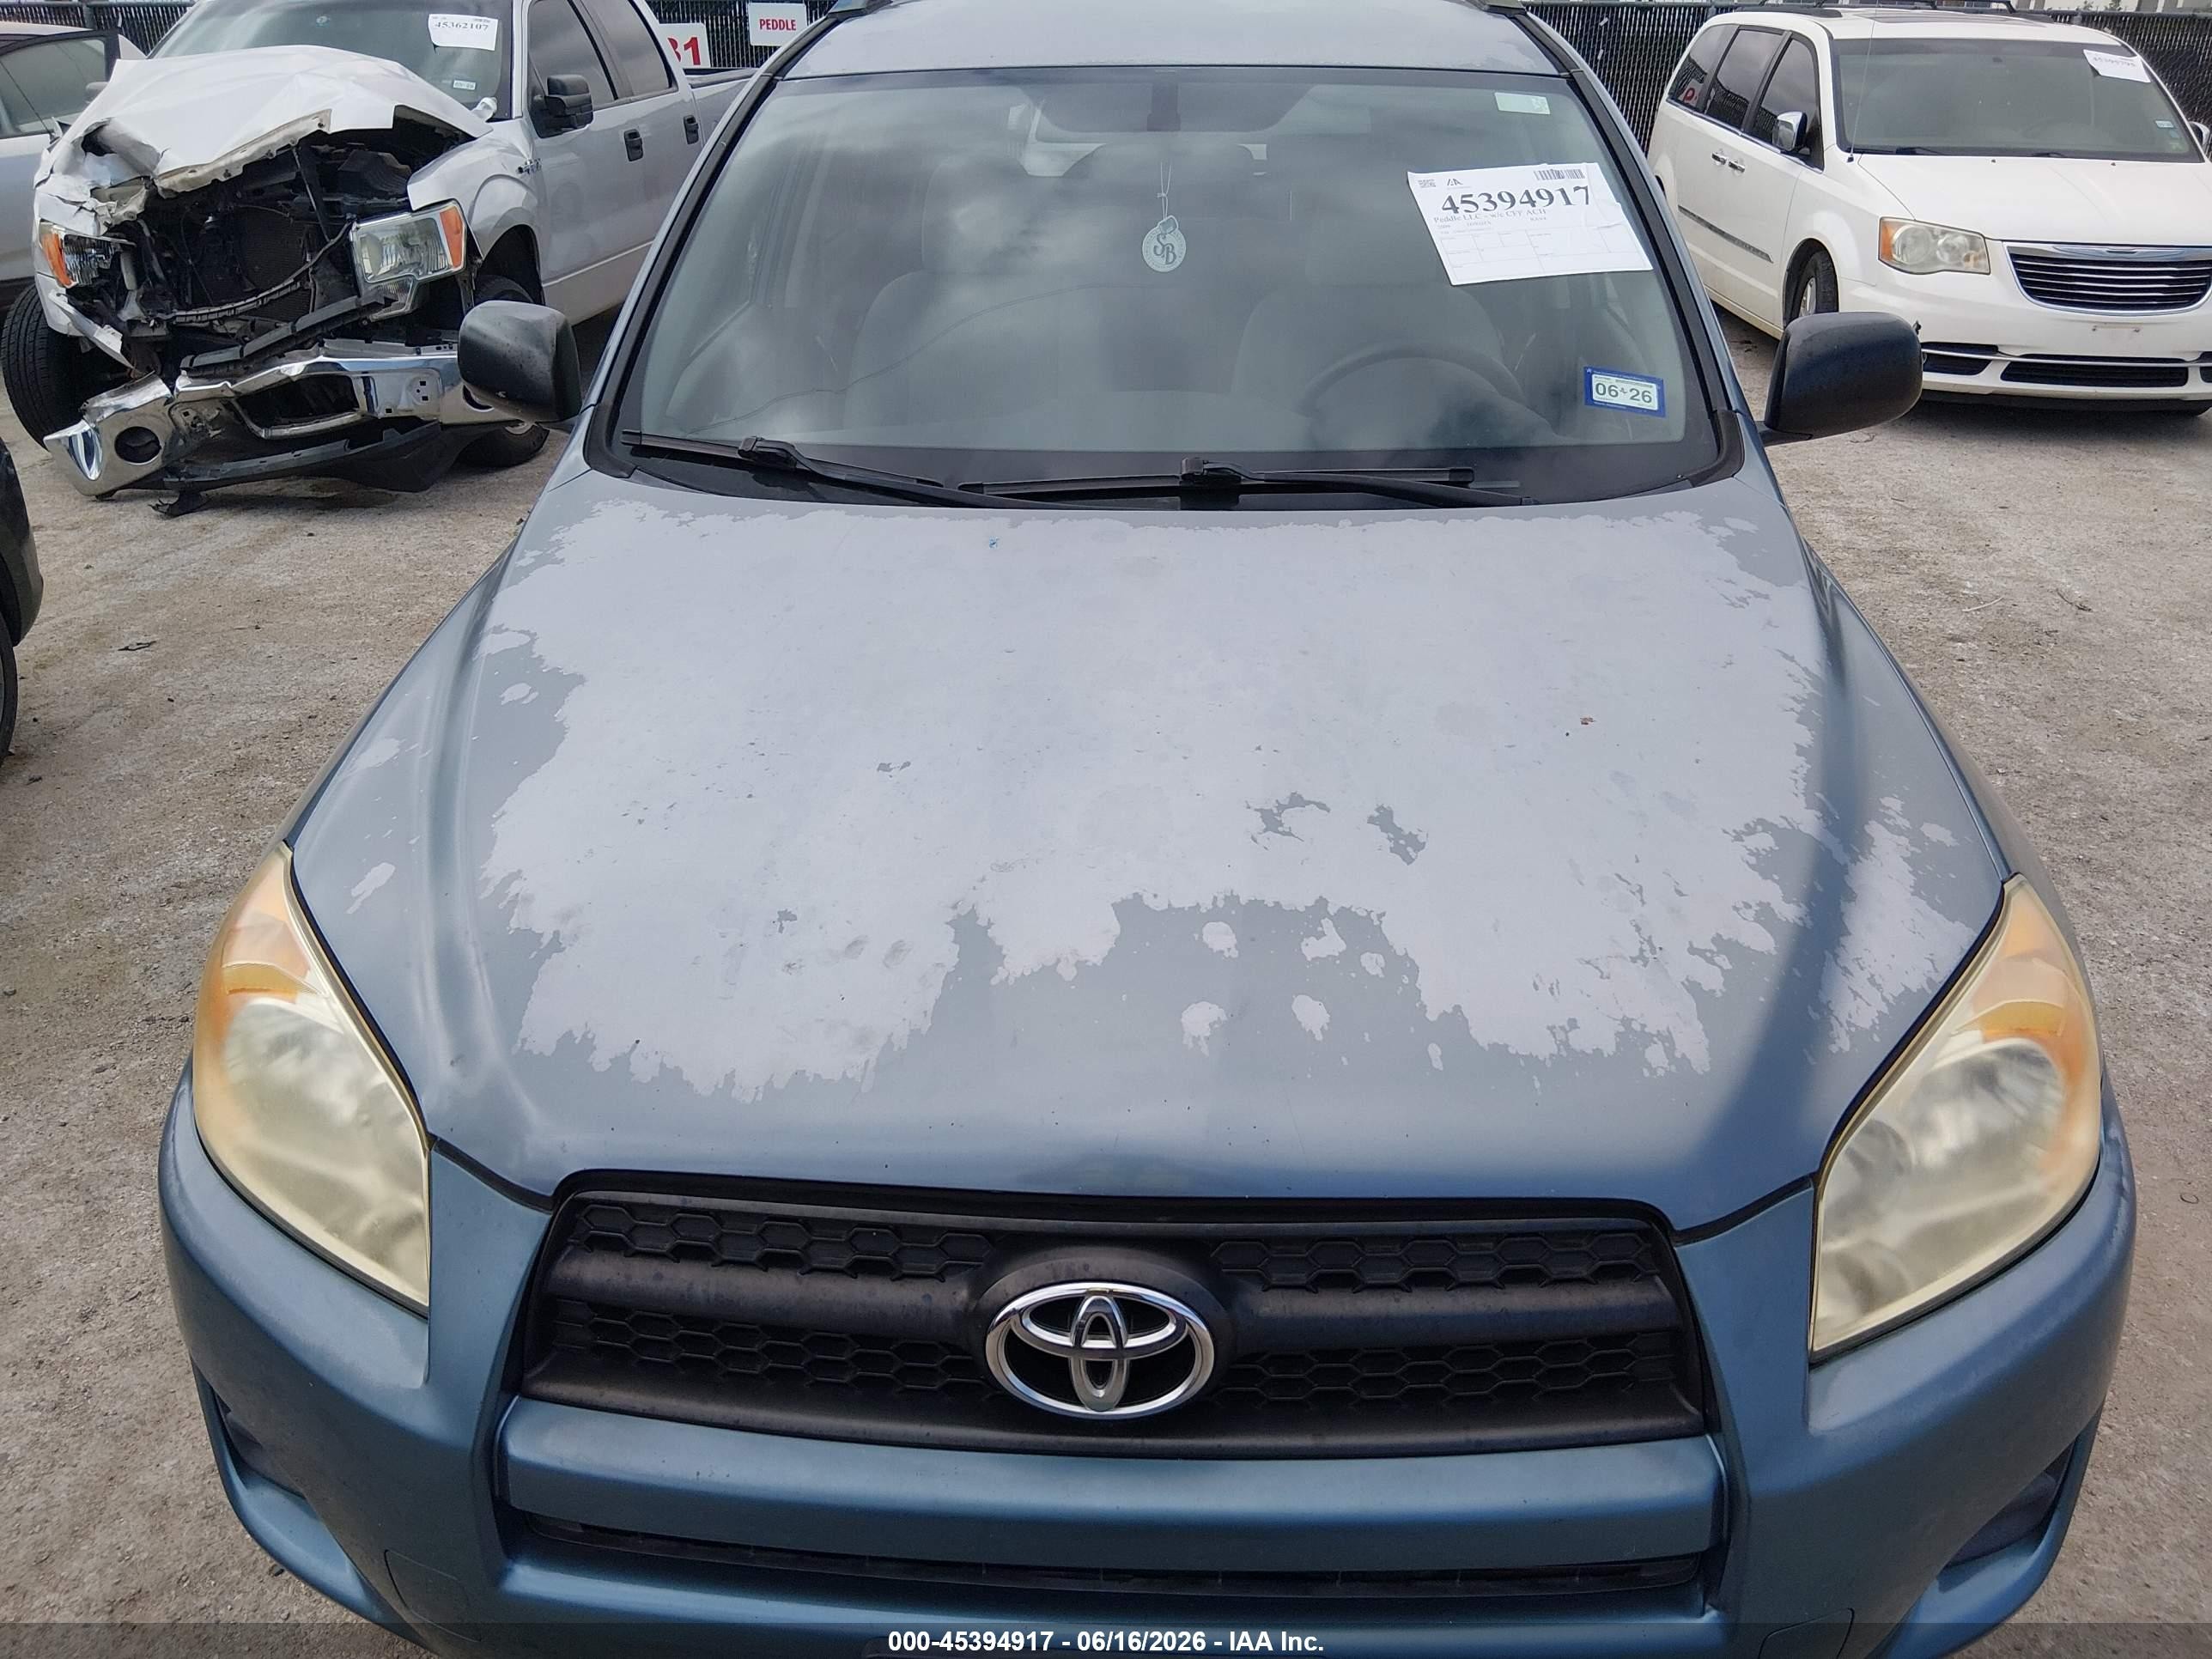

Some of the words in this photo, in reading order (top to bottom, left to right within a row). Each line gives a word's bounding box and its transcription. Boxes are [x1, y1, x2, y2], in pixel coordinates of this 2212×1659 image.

[434, 21, 489, 32] 45362107
[758, 18, 797, 32] PEDDLE
[1442, 185, 1589, 215] 45394917
[1434, 214, 1462, 223] Peddle
[1595, 382, 1620, 398] 06
[1629, 387, 1652, 404] 26
